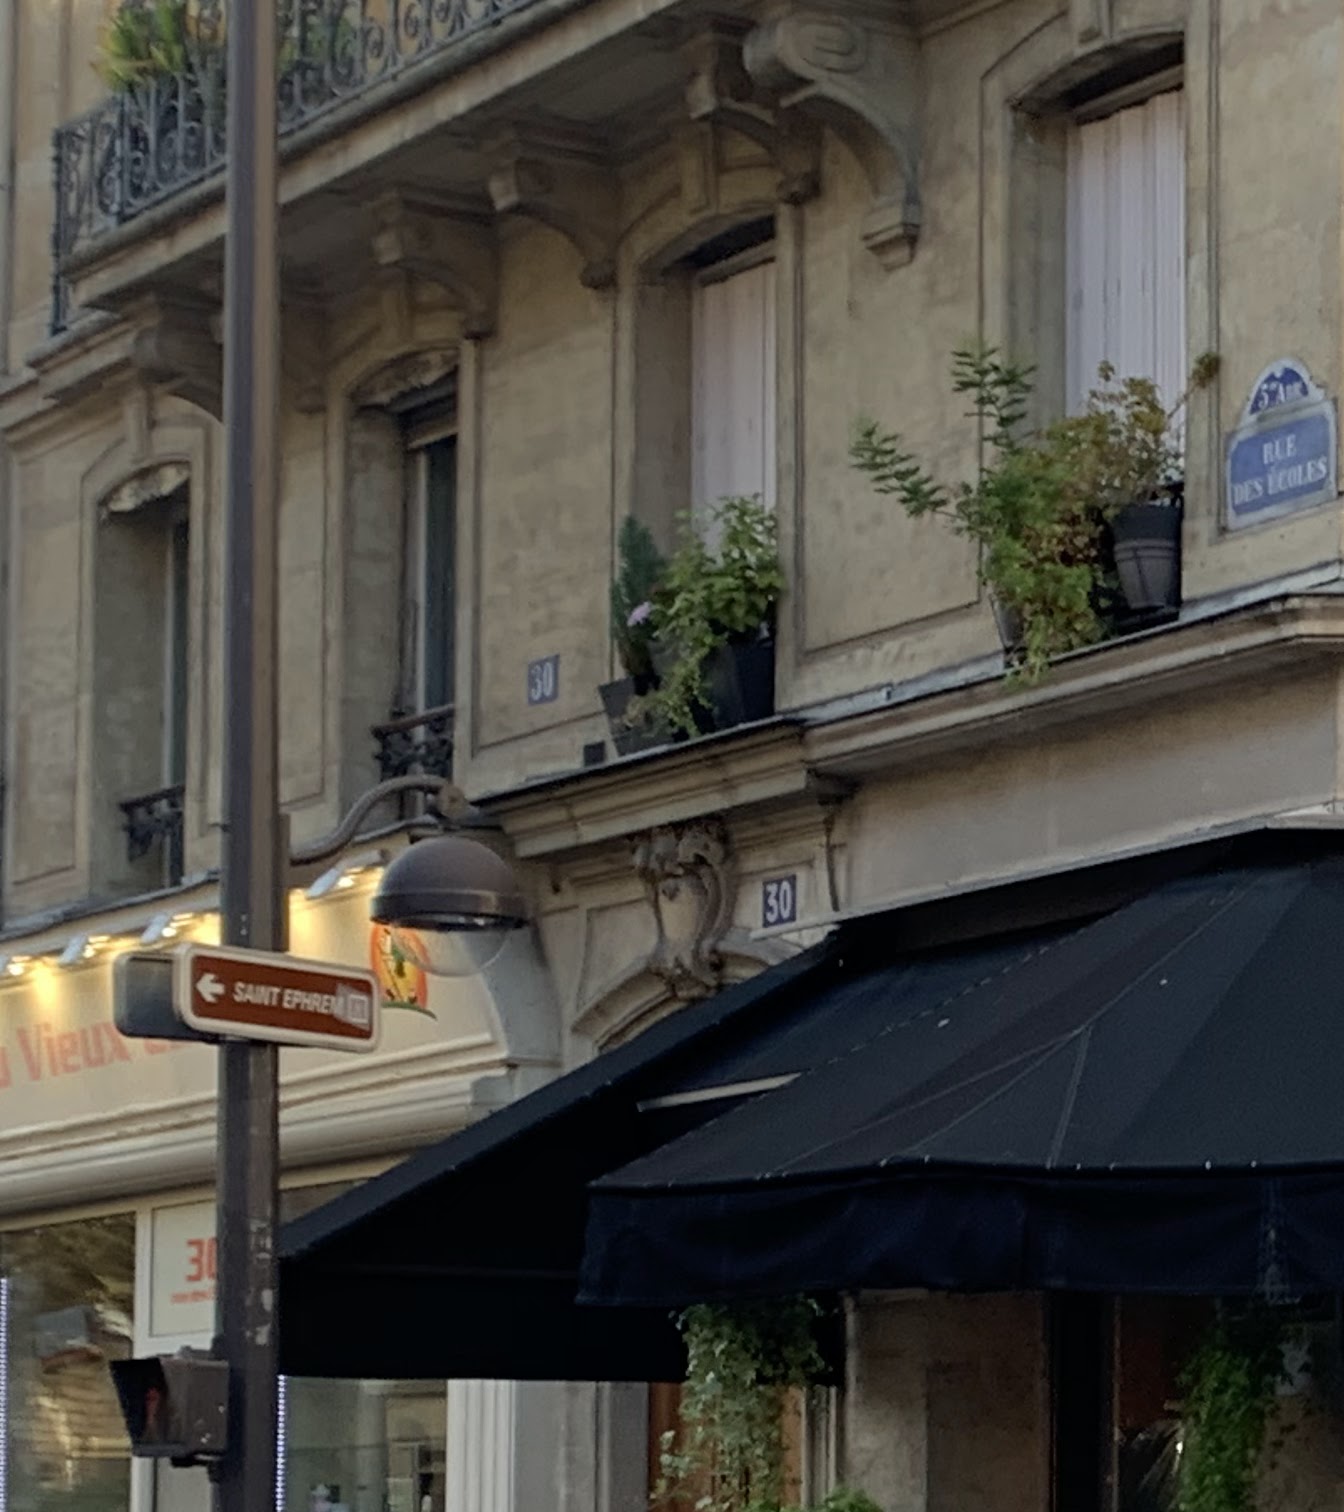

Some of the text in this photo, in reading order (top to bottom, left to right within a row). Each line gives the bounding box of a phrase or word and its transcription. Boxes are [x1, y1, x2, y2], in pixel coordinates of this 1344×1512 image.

[1262, 434, 1297, 465] RUE
[1233, 477, 1264, 505] DES
[233, 980, 281, 1007] SAINT
[15, 1021, 133, 1082] Vieux
